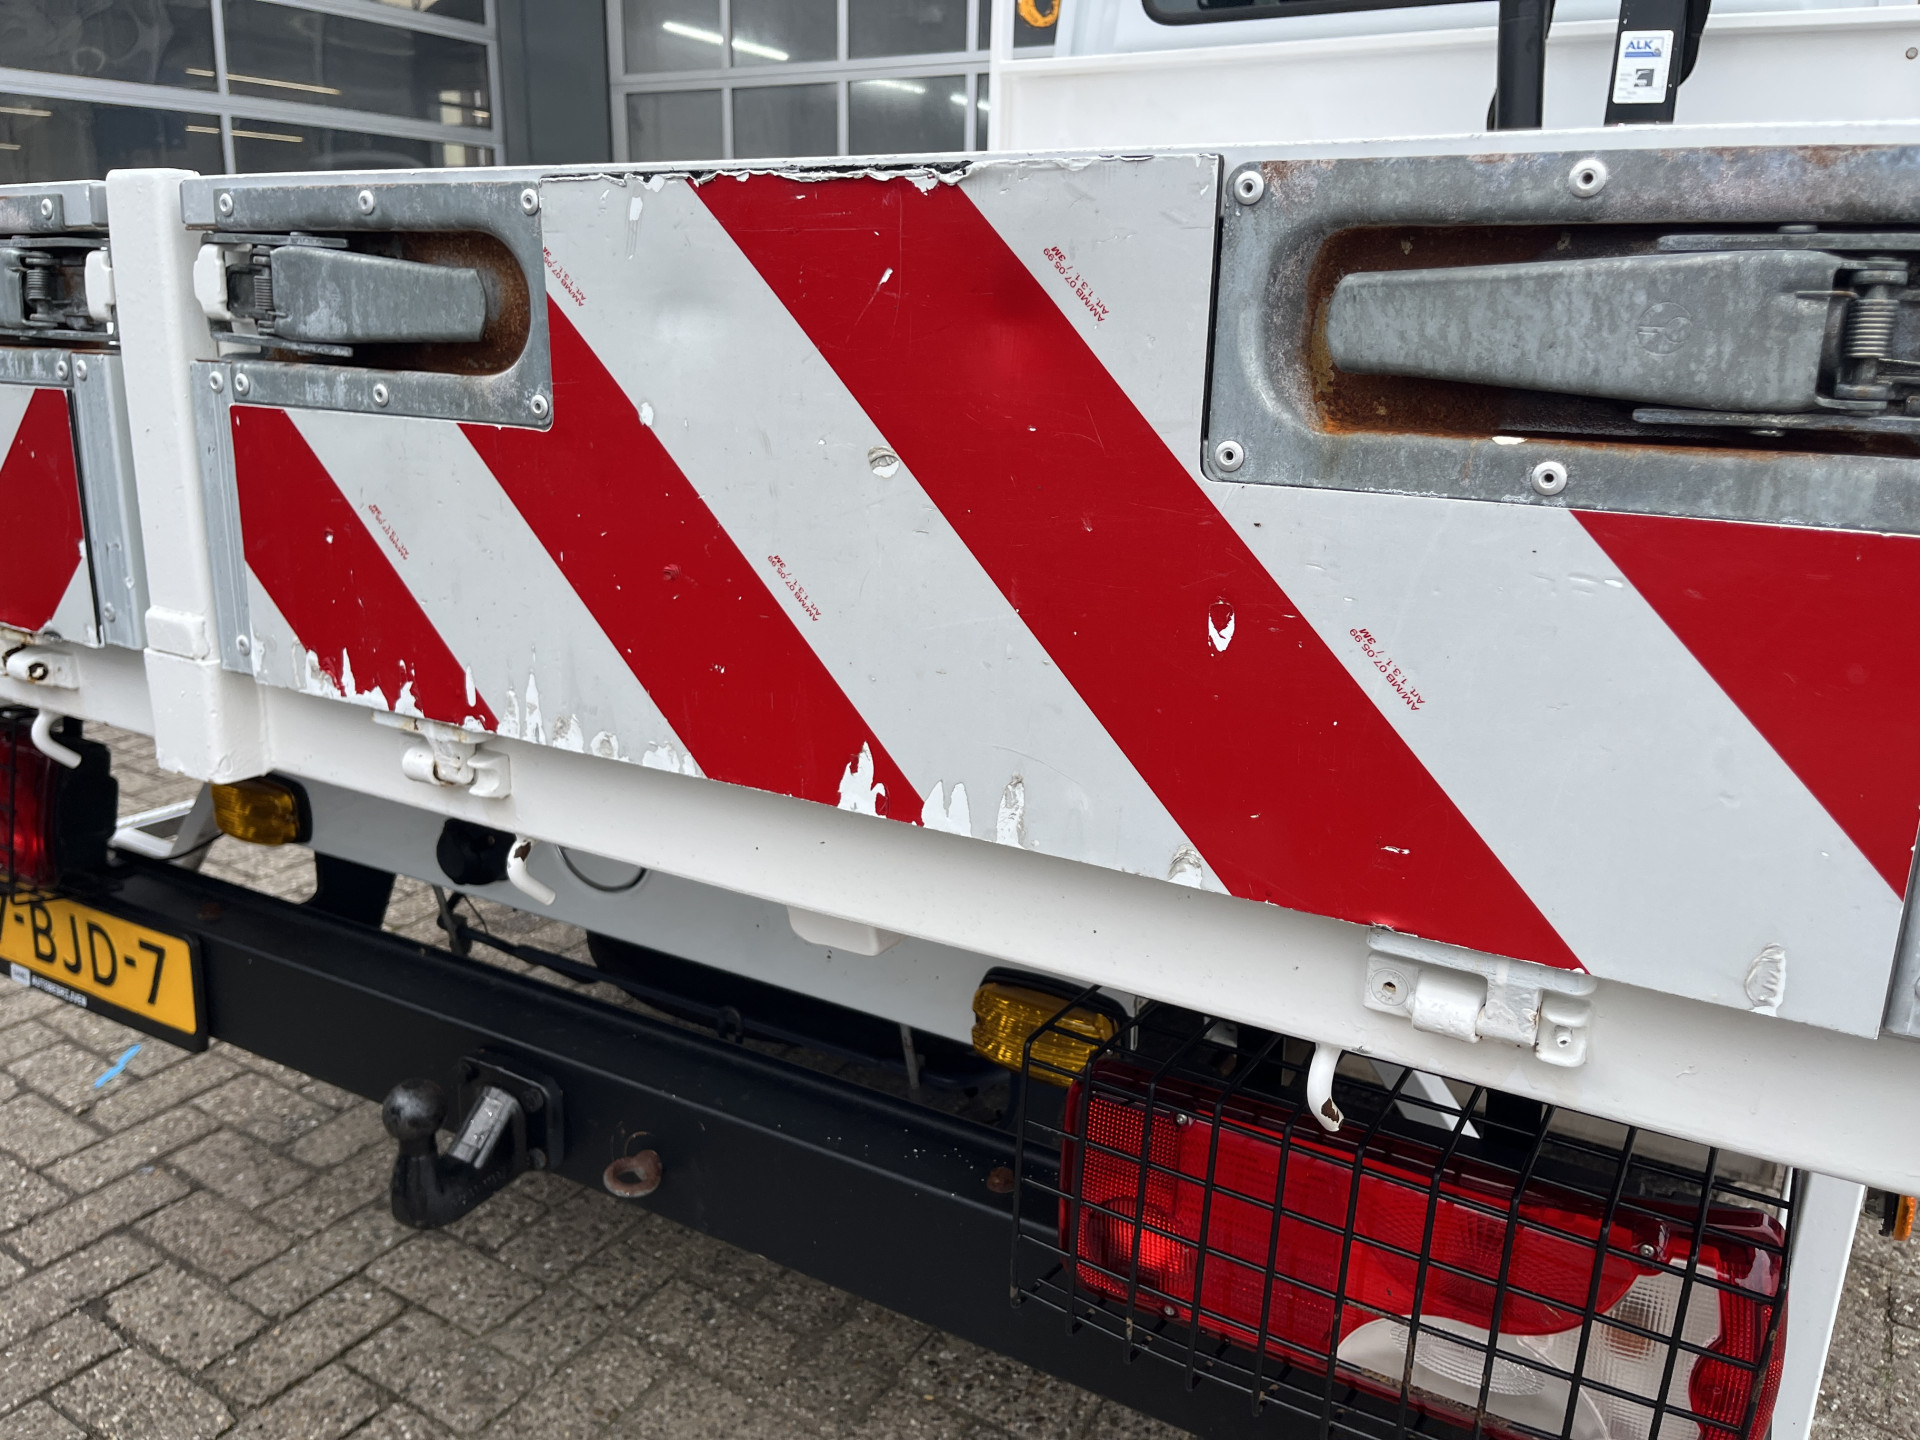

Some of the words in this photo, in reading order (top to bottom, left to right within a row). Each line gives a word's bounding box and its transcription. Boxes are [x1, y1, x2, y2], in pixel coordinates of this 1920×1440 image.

[1626, 40, 1653, 50] ALK
[1050, 246, 1066, 262] 3M
[1043, 247, 1077, 288] 07.05.99
[1075, 287, 1105, 322] AM/MB
[1096, 298, 1110, 315] Art.
[773, 555, 786, 568] 3M
[794, 591, 819, 622] AM/MB
[1357, 628, 1377, 645] 3M
[1349, 628, 1388, 673] 07.05.99
[1386, 673, 1419, 711] AM/MB
[1409, 687, 1425, 704] Art.
